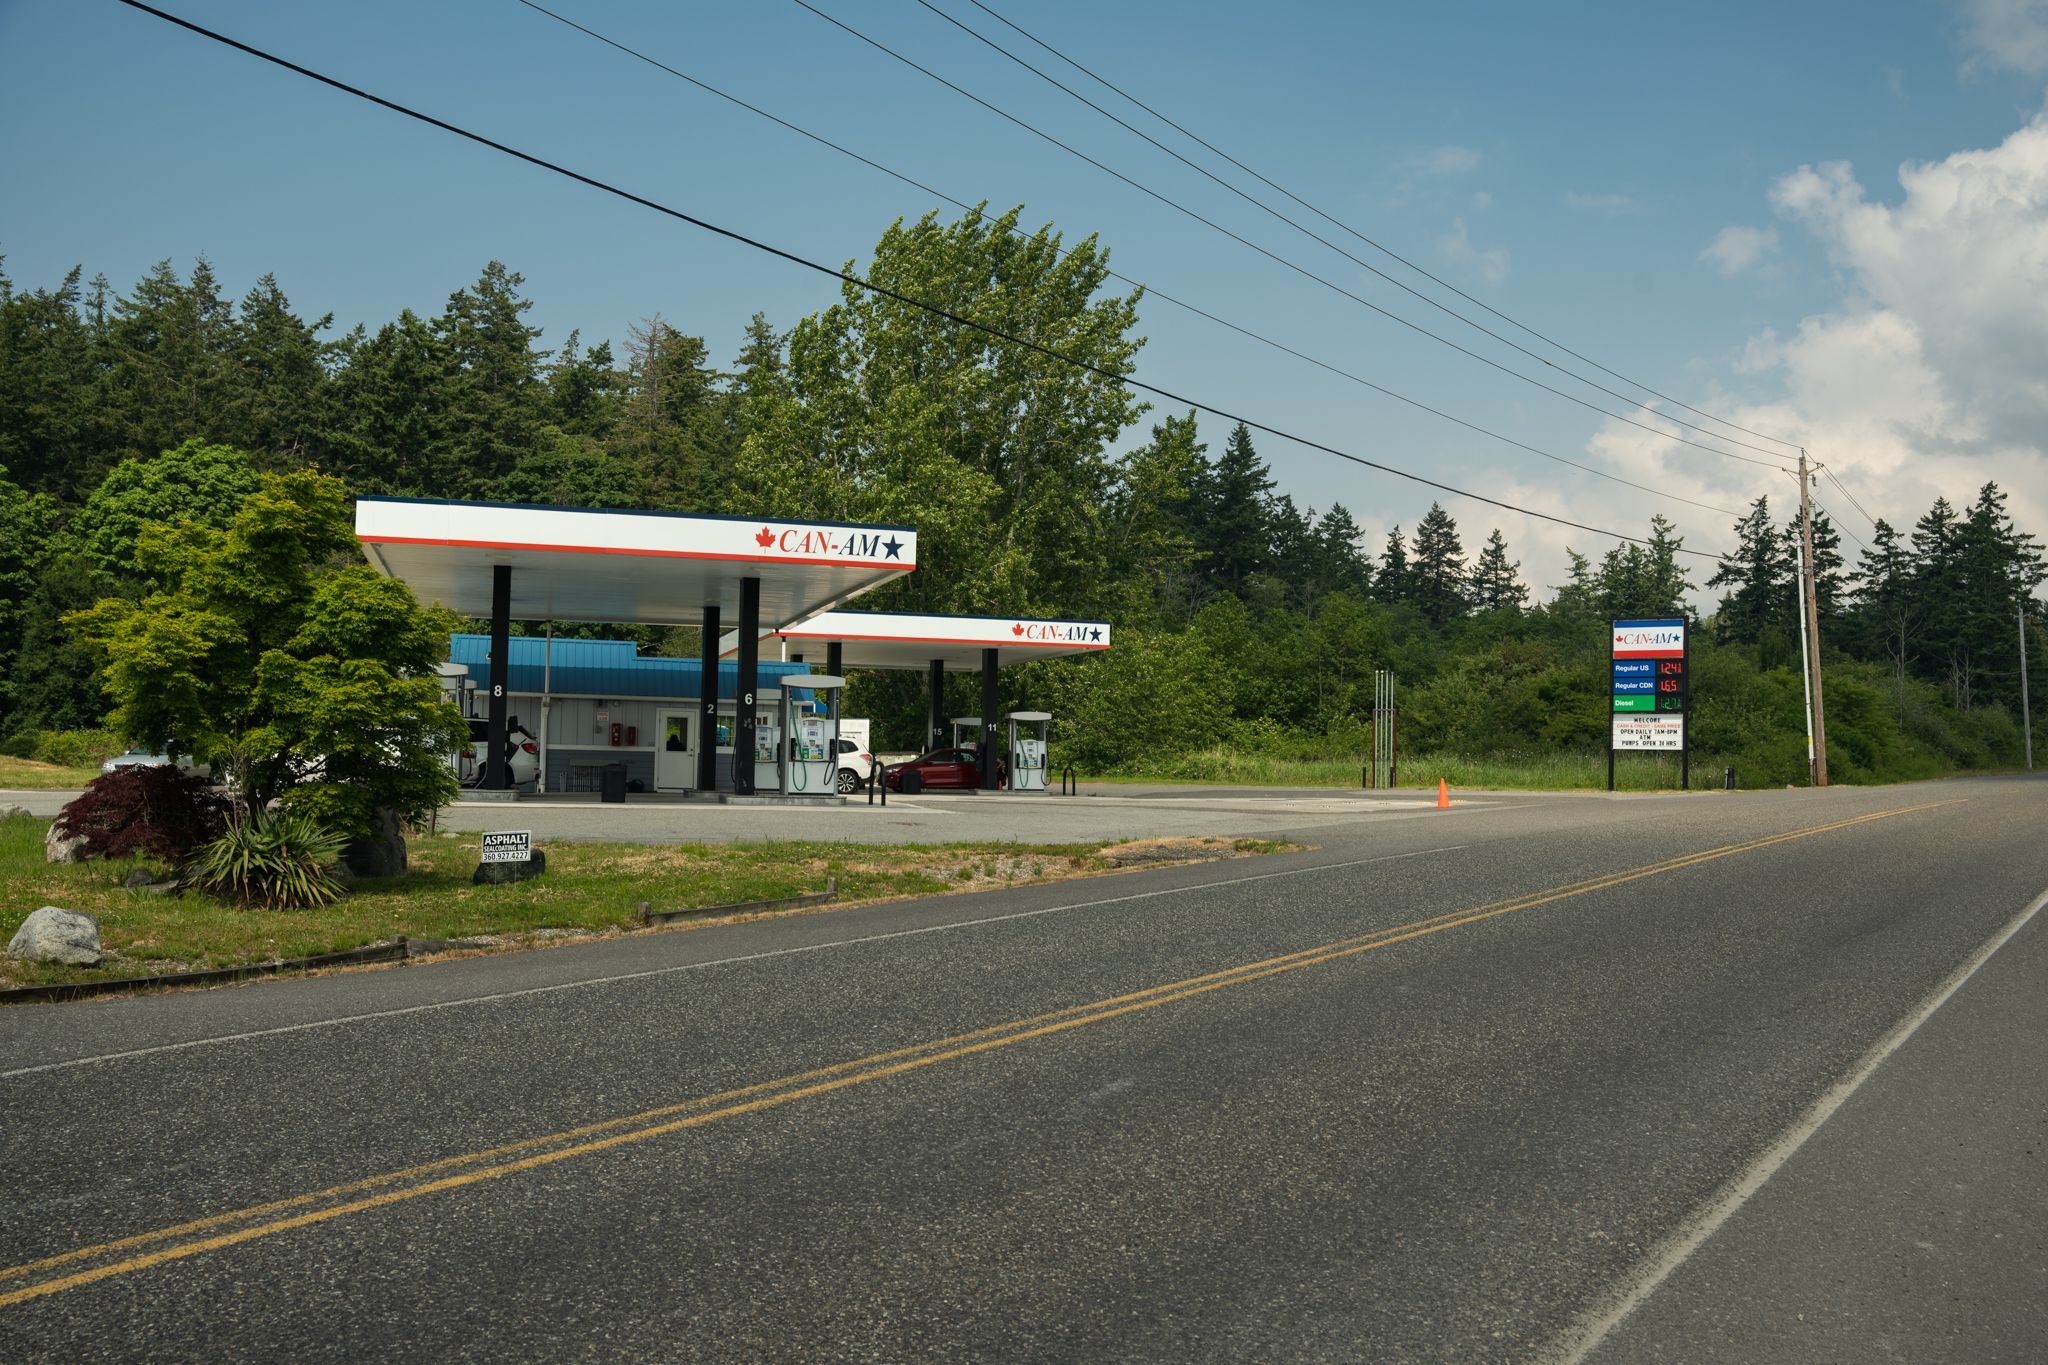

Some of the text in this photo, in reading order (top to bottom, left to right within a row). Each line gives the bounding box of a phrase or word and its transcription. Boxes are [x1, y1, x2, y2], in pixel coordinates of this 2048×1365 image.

[779, 529, 881, 557] CAN-AM
[1026, 624, 1088, 641] CAN-AM
[1624, 633, 1672, 644] CAN-AM
[494, 685, 502, 697] 8
[744, 693, 753, 705] 6
[707, 704, 714, 714] 2
[988, 723, 997, 731] 11
[484, 834, 528, 846] ASPHALT
[484, 844, 517, 852] SEALCOATING
[484, 852, 528, 861] 360.927.4227
